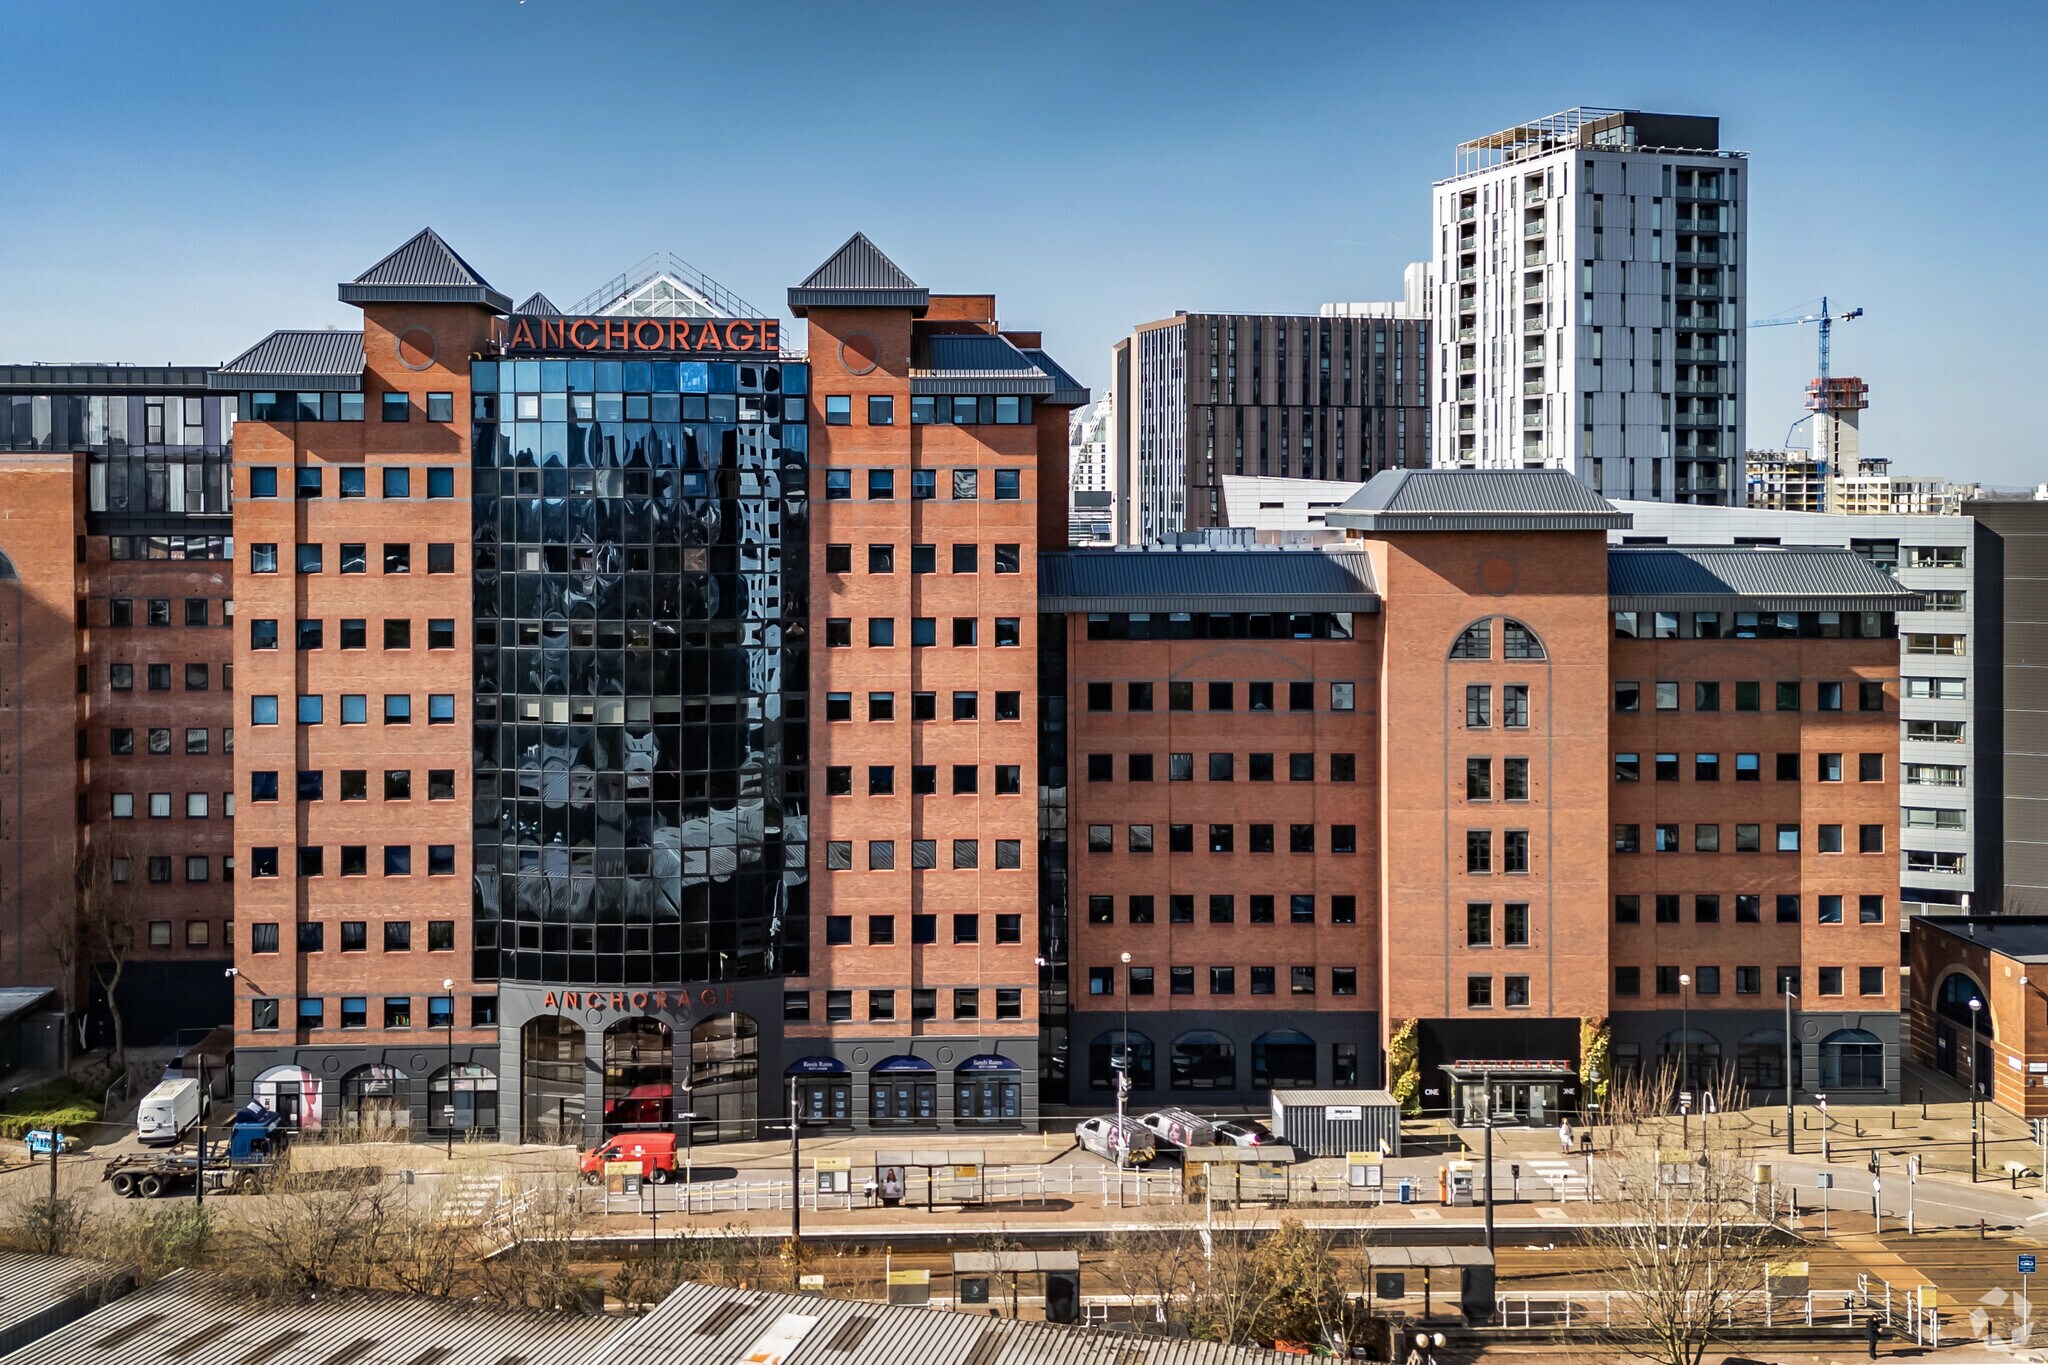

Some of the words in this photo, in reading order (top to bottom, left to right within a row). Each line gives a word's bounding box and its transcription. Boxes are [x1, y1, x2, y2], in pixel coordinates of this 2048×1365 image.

[510, 318, 778, 351] ANCHORAGE
[543, 987, 737, 1009] ANCHORAGE
[1454, 1059, 1571, 1070] ANCHORAGE
[1424, 1088, 1440, 1096] ONE
